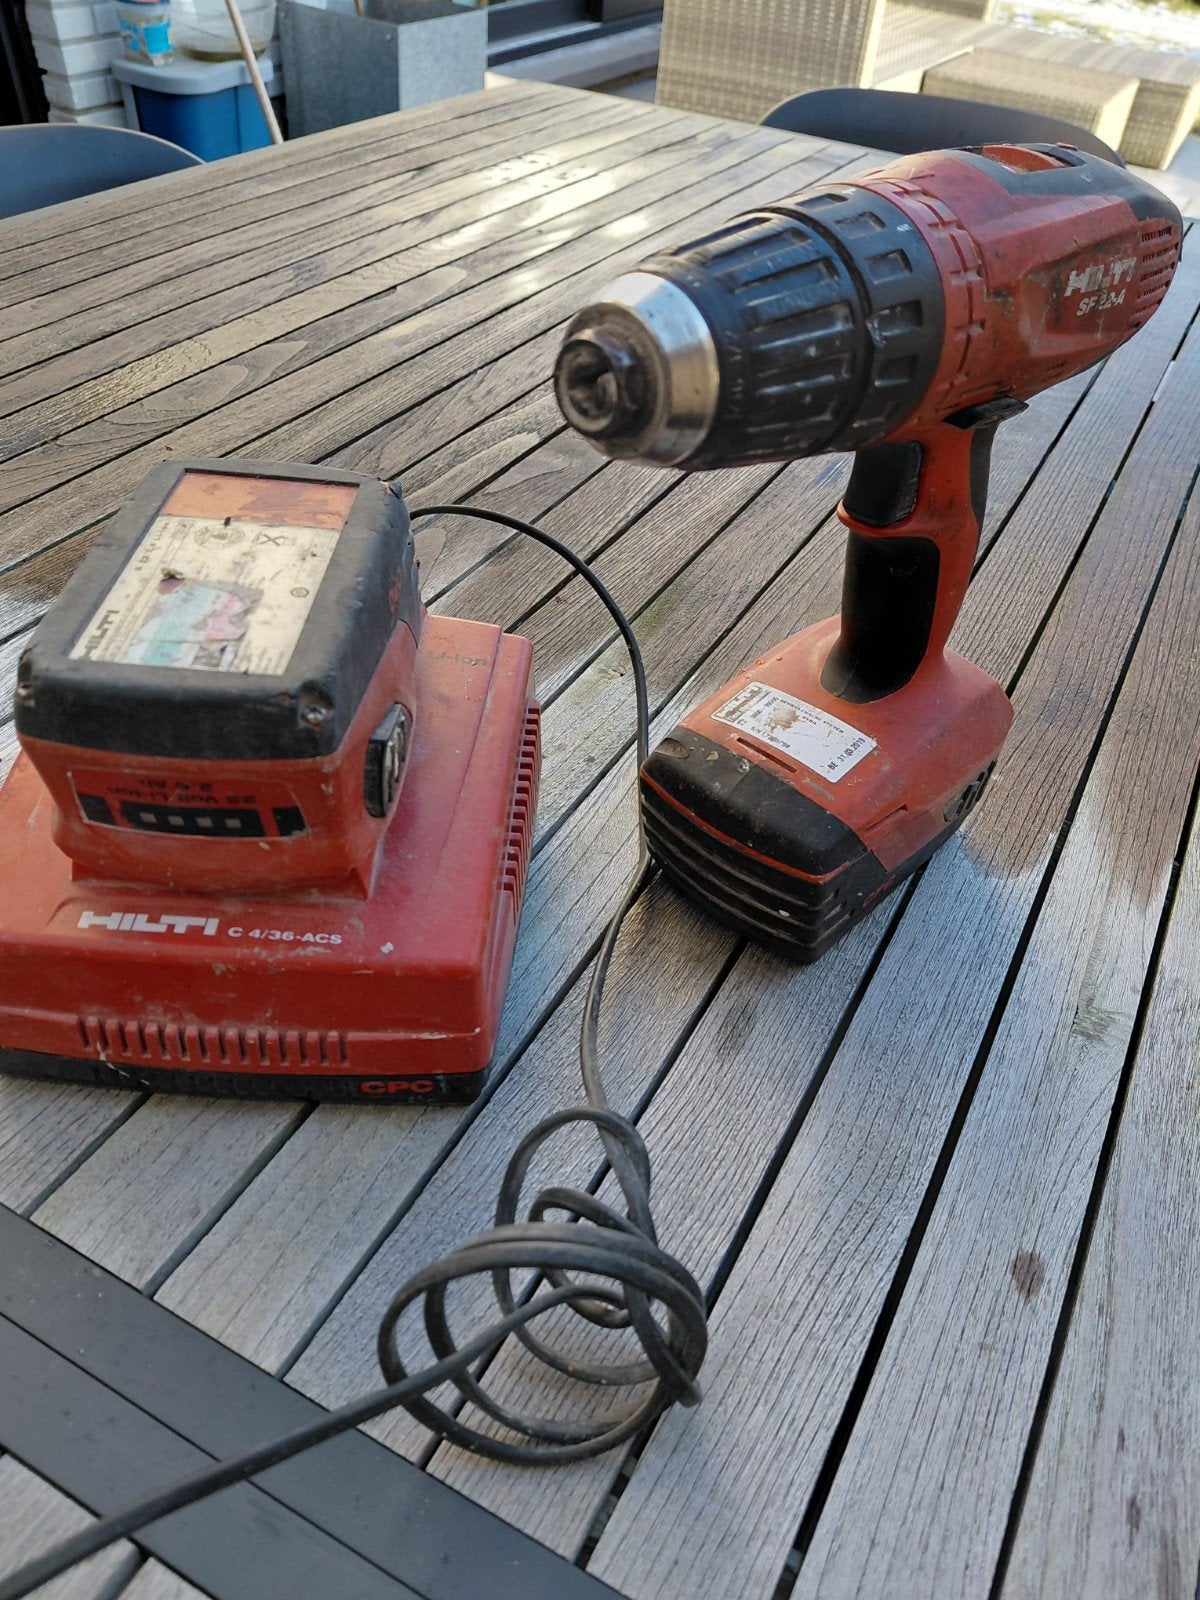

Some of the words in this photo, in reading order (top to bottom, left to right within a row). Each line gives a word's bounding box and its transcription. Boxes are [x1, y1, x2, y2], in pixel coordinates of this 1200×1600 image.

[1075, 297, 1097, 317] SF
[77, 910, 220, 936] HILTI
[228, 926, 243, 938] C
[248, 928, 342, 945] 4/36-ACS
[359, 1080, 434, 1096] CPC
